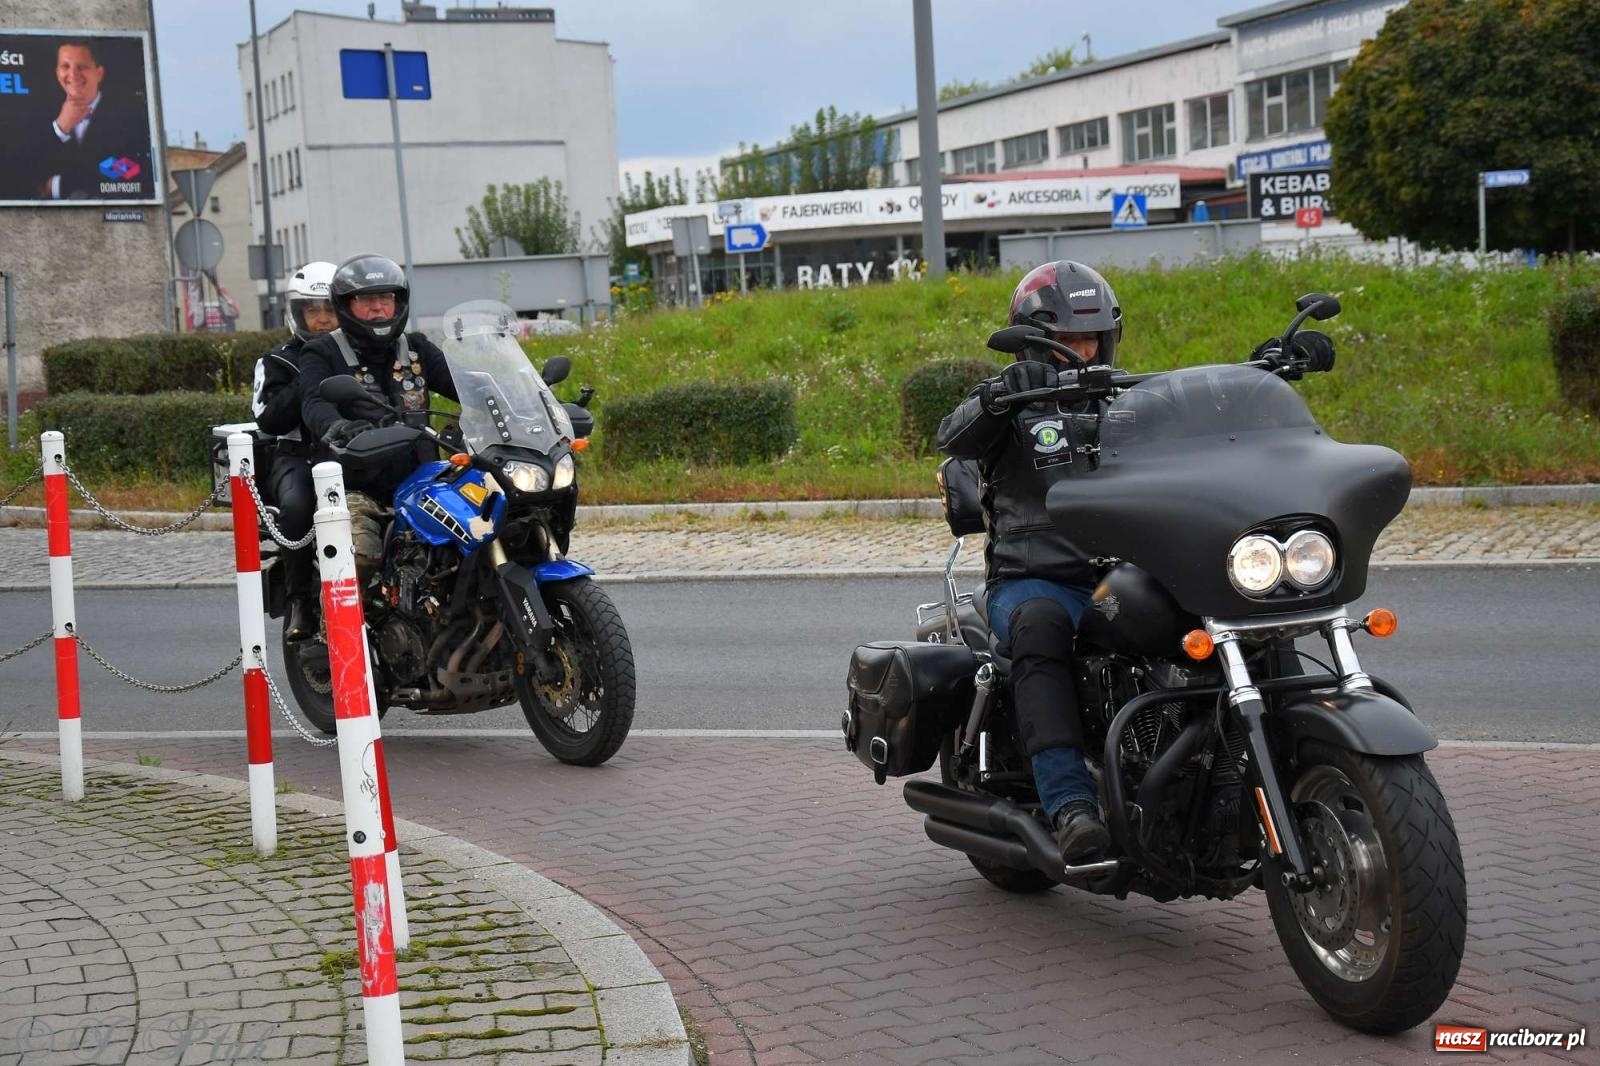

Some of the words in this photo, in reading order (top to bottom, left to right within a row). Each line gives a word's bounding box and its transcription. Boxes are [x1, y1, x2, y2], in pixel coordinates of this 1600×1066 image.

[1260, 173, 1331, 195] KEBAB
[782, 201, 863, 219] FAJERWERKI
[1008, 189, 1082, 205] AKCESORIA
[1261, 198, 1276, 216] &
[1302, 211, 1317, 224] 45
[797, 261, 874, 290] RATY
[1069, 288, 1096, 298] NOLAN
[523, 597, 537, 627] YAMAHA
